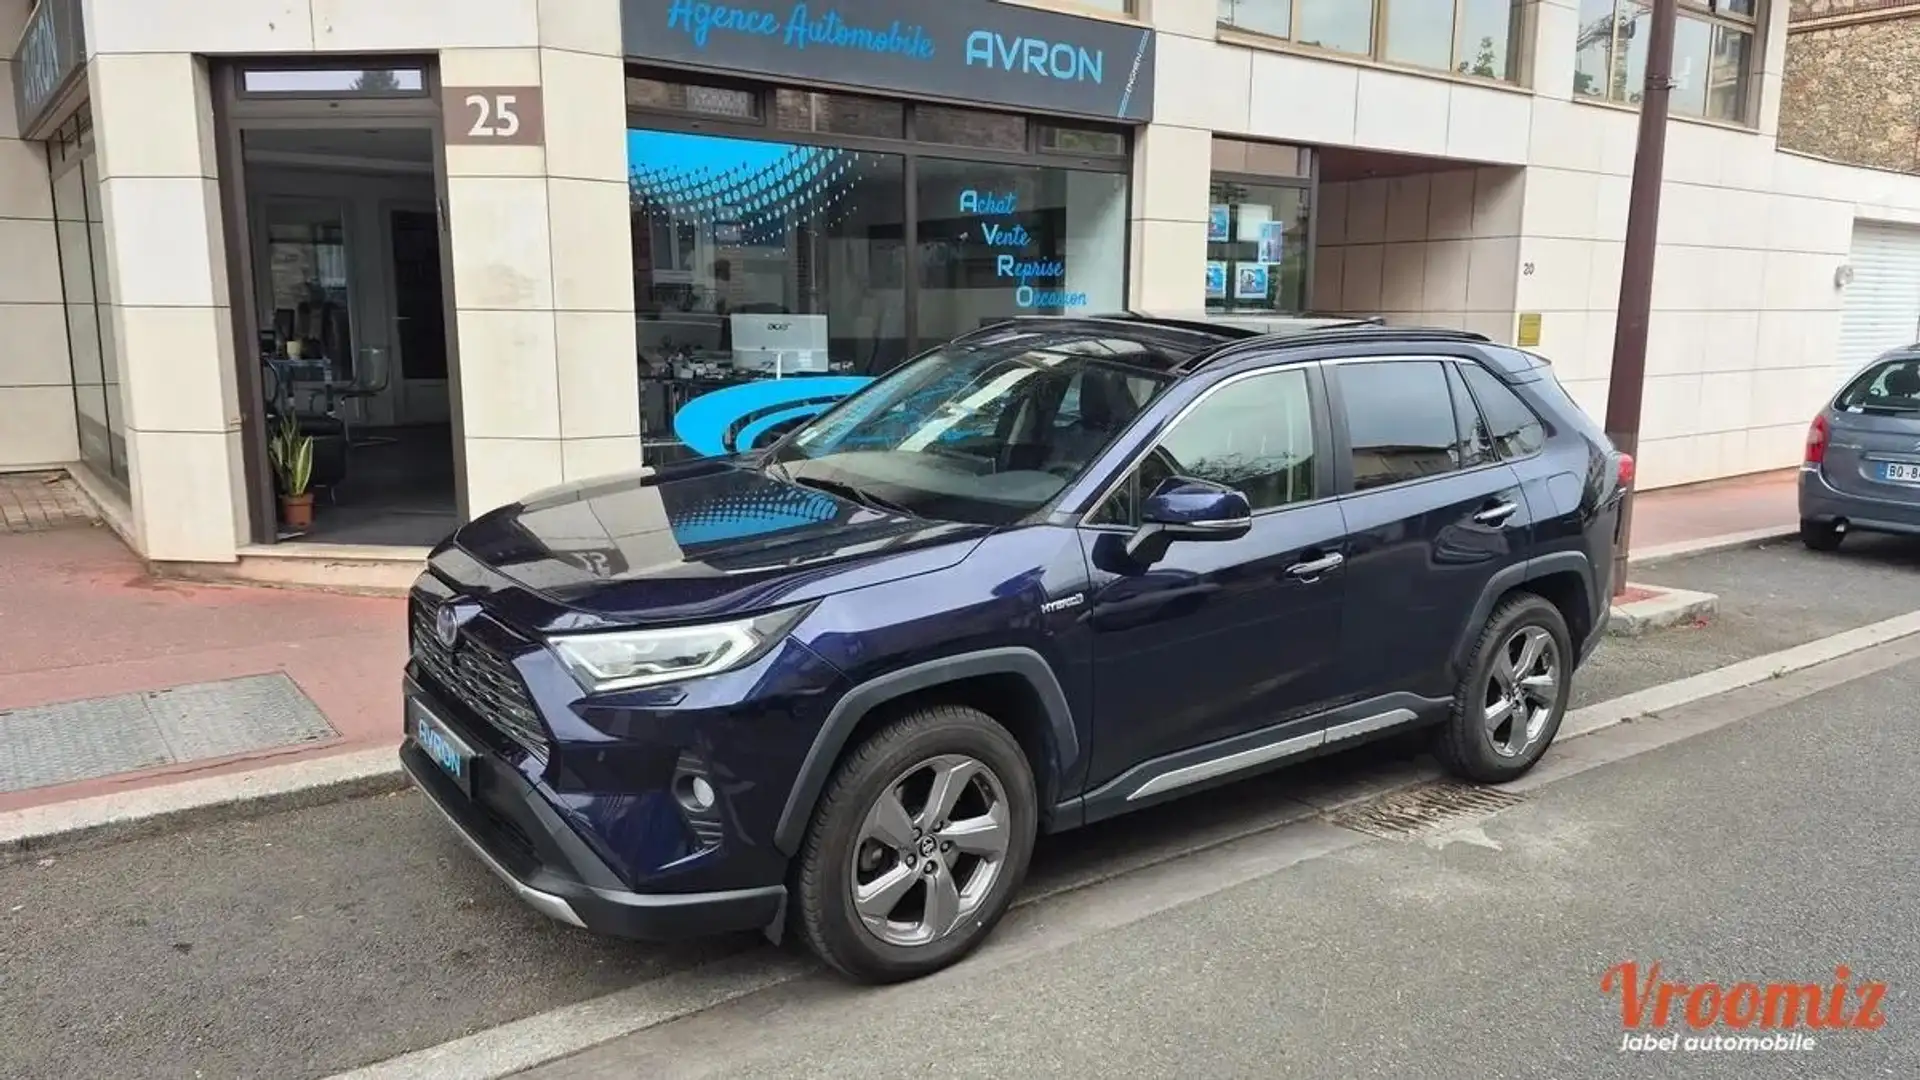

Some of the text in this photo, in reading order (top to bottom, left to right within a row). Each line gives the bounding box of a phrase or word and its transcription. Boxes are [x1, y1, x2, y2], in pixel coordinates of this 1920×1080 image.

[668, 0, 934, 58] Agence Automobile
[966, 30, 1103, 84] AVRON
[466, 95, 519, 136] 25
[960, 190, 1016, 214] Achat
[981, 222, 1031, 246] Vente
[997, 254, 1064, 286] Reprise
[1523, 262, 1535, 276] 20
[1015, 286, 1087, 307] Occasion
[767, 323, 792, 331] acer
[1890, 465, 1920, 479] BQ-8
[1041, 593, 1084, 614] HYBRID
[419, 719, 461, 778] AVRON
